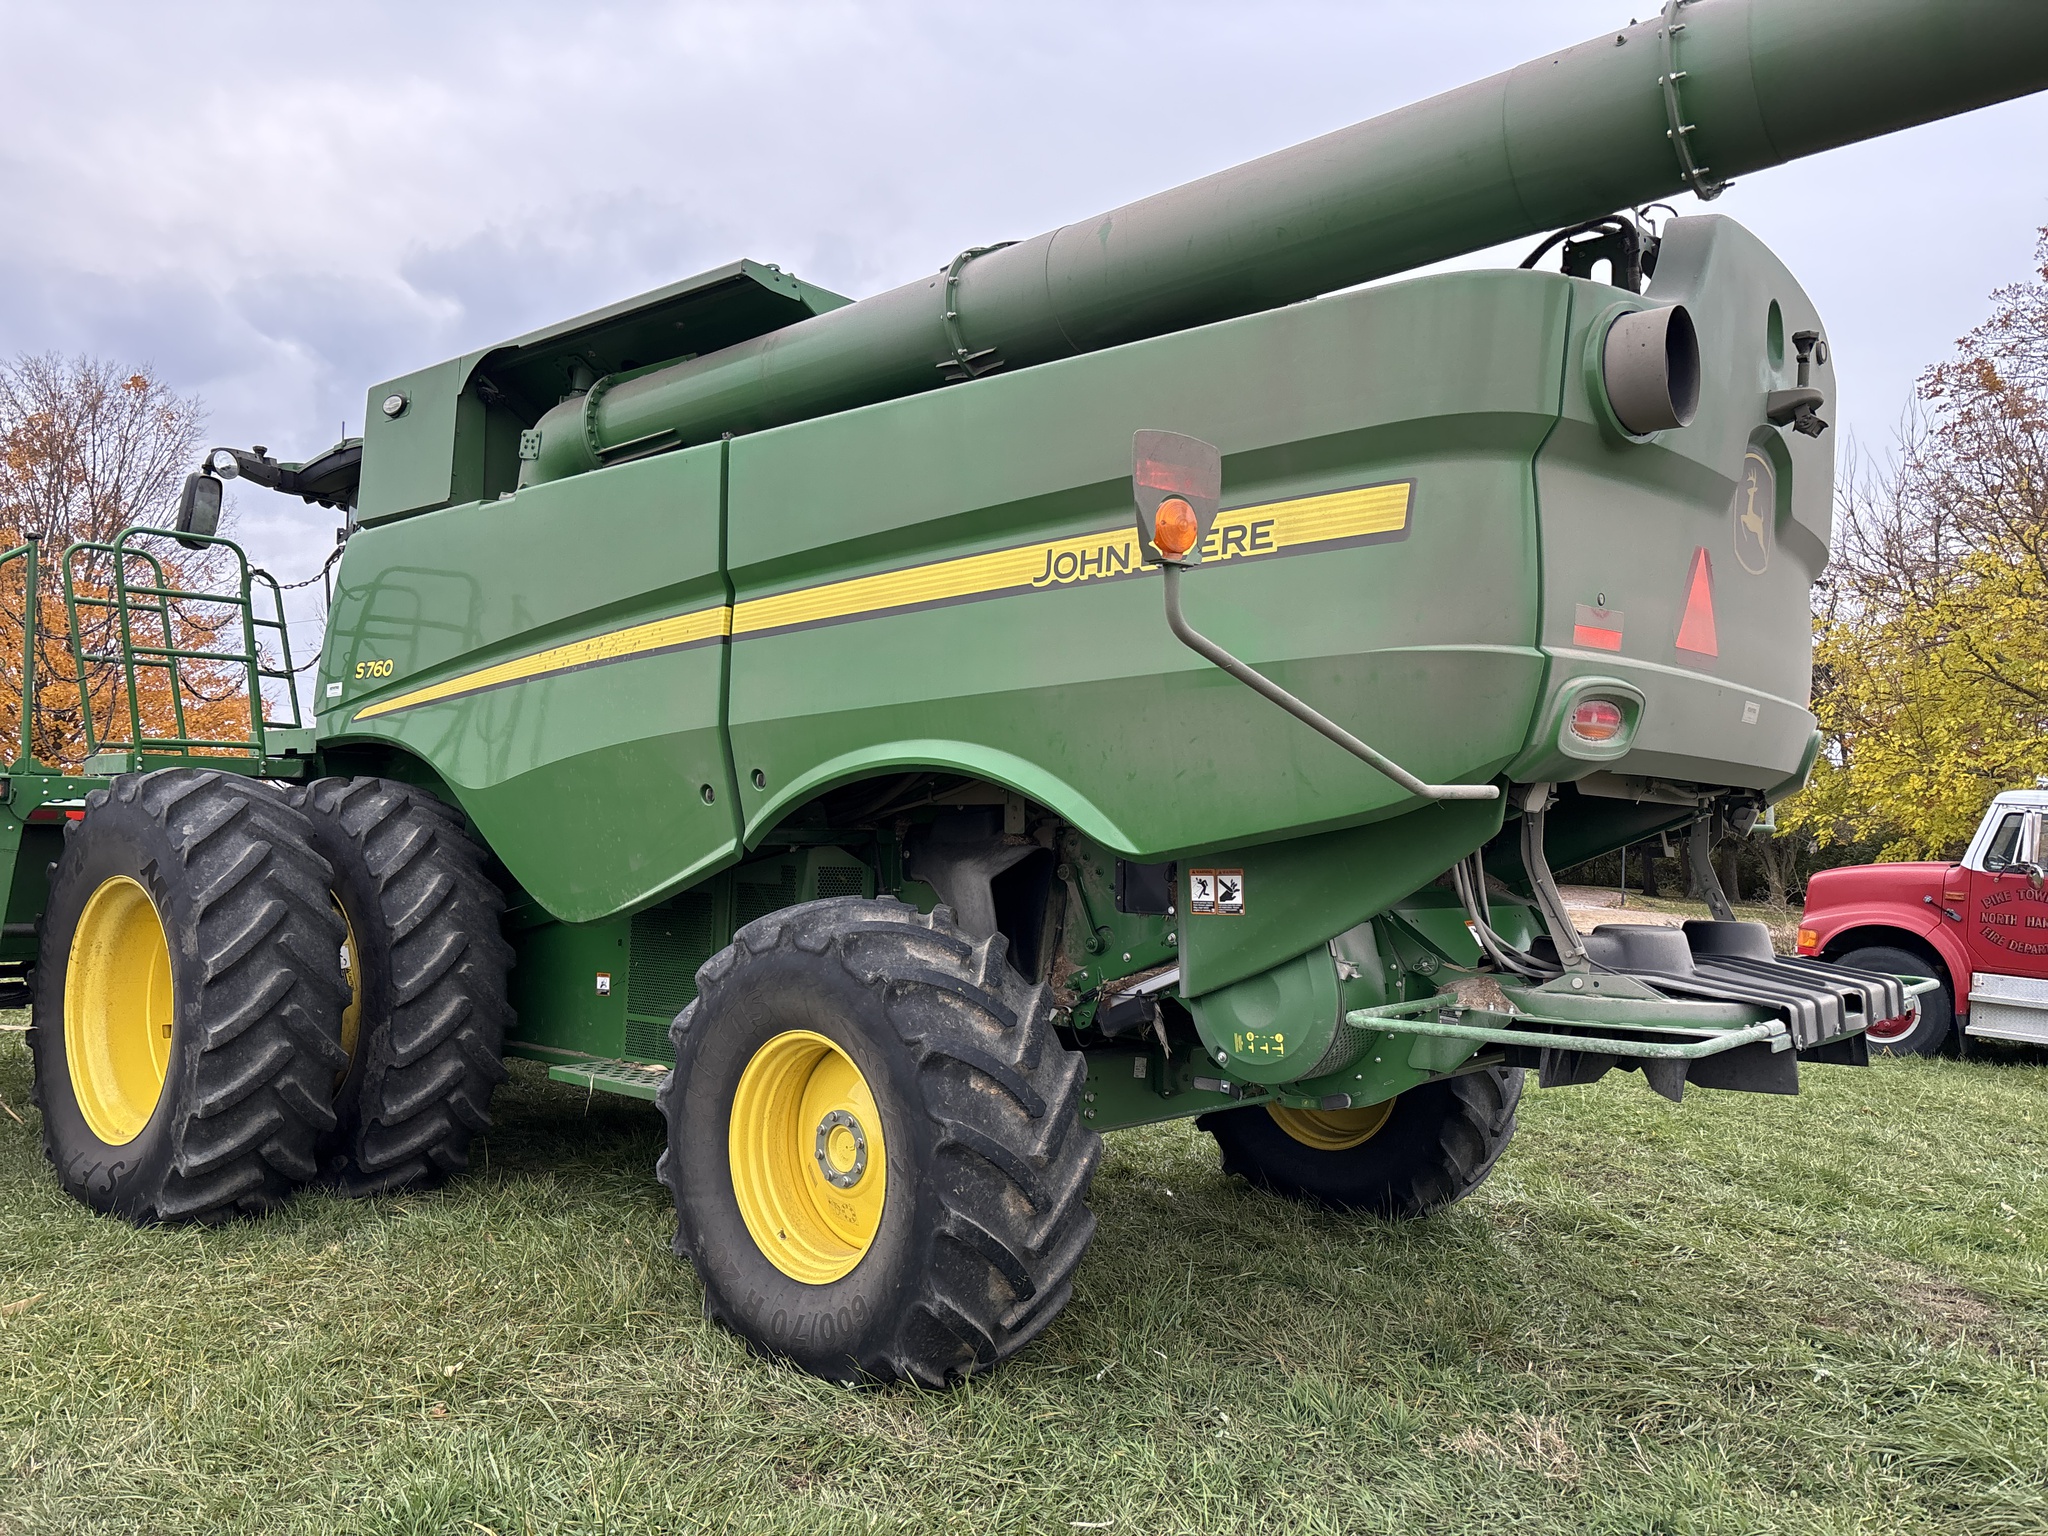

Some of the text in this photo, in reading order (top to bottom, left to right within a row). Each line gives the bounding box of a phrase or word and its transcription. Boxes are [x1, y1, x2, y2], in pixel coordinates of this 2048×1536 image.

[1033, 542, 1130, 583] JOHN
[355, 659, 394, 679] S760
[1981, 889, 2048, 909] PIKE TOW
[1981, 912, 2018, 926] NORTH
[1980, 927, 2006, 946] FIRE
[770, 1294, 870, 1348] 600/70
